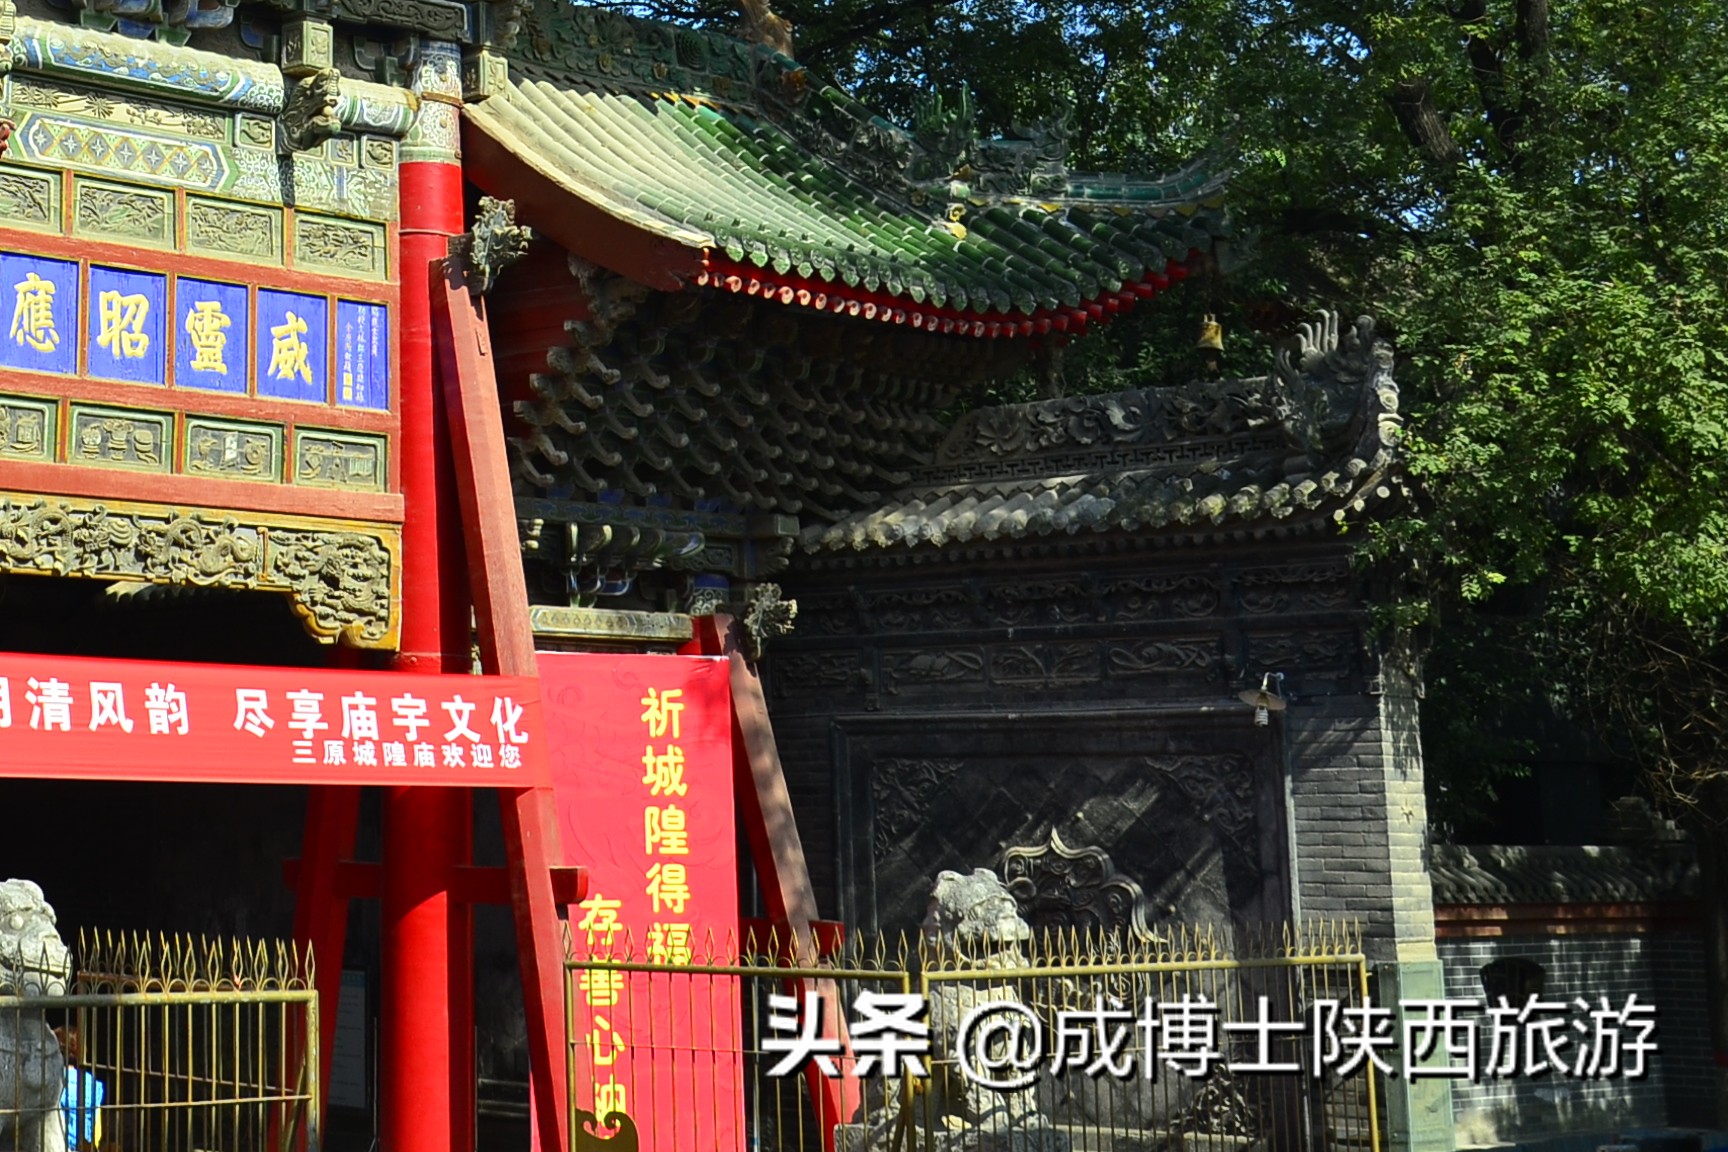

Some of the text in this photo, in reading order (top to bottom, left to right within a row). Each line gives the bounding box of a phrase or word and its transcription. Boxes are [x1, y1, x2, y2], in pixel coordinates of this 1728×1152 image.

[233, 689, 529, 744] 尽享庙宇文化
[292, 740, 522, 769] 三原城隍庙欢迎您
[641, 687, 691, 966] 祈城隍得福
